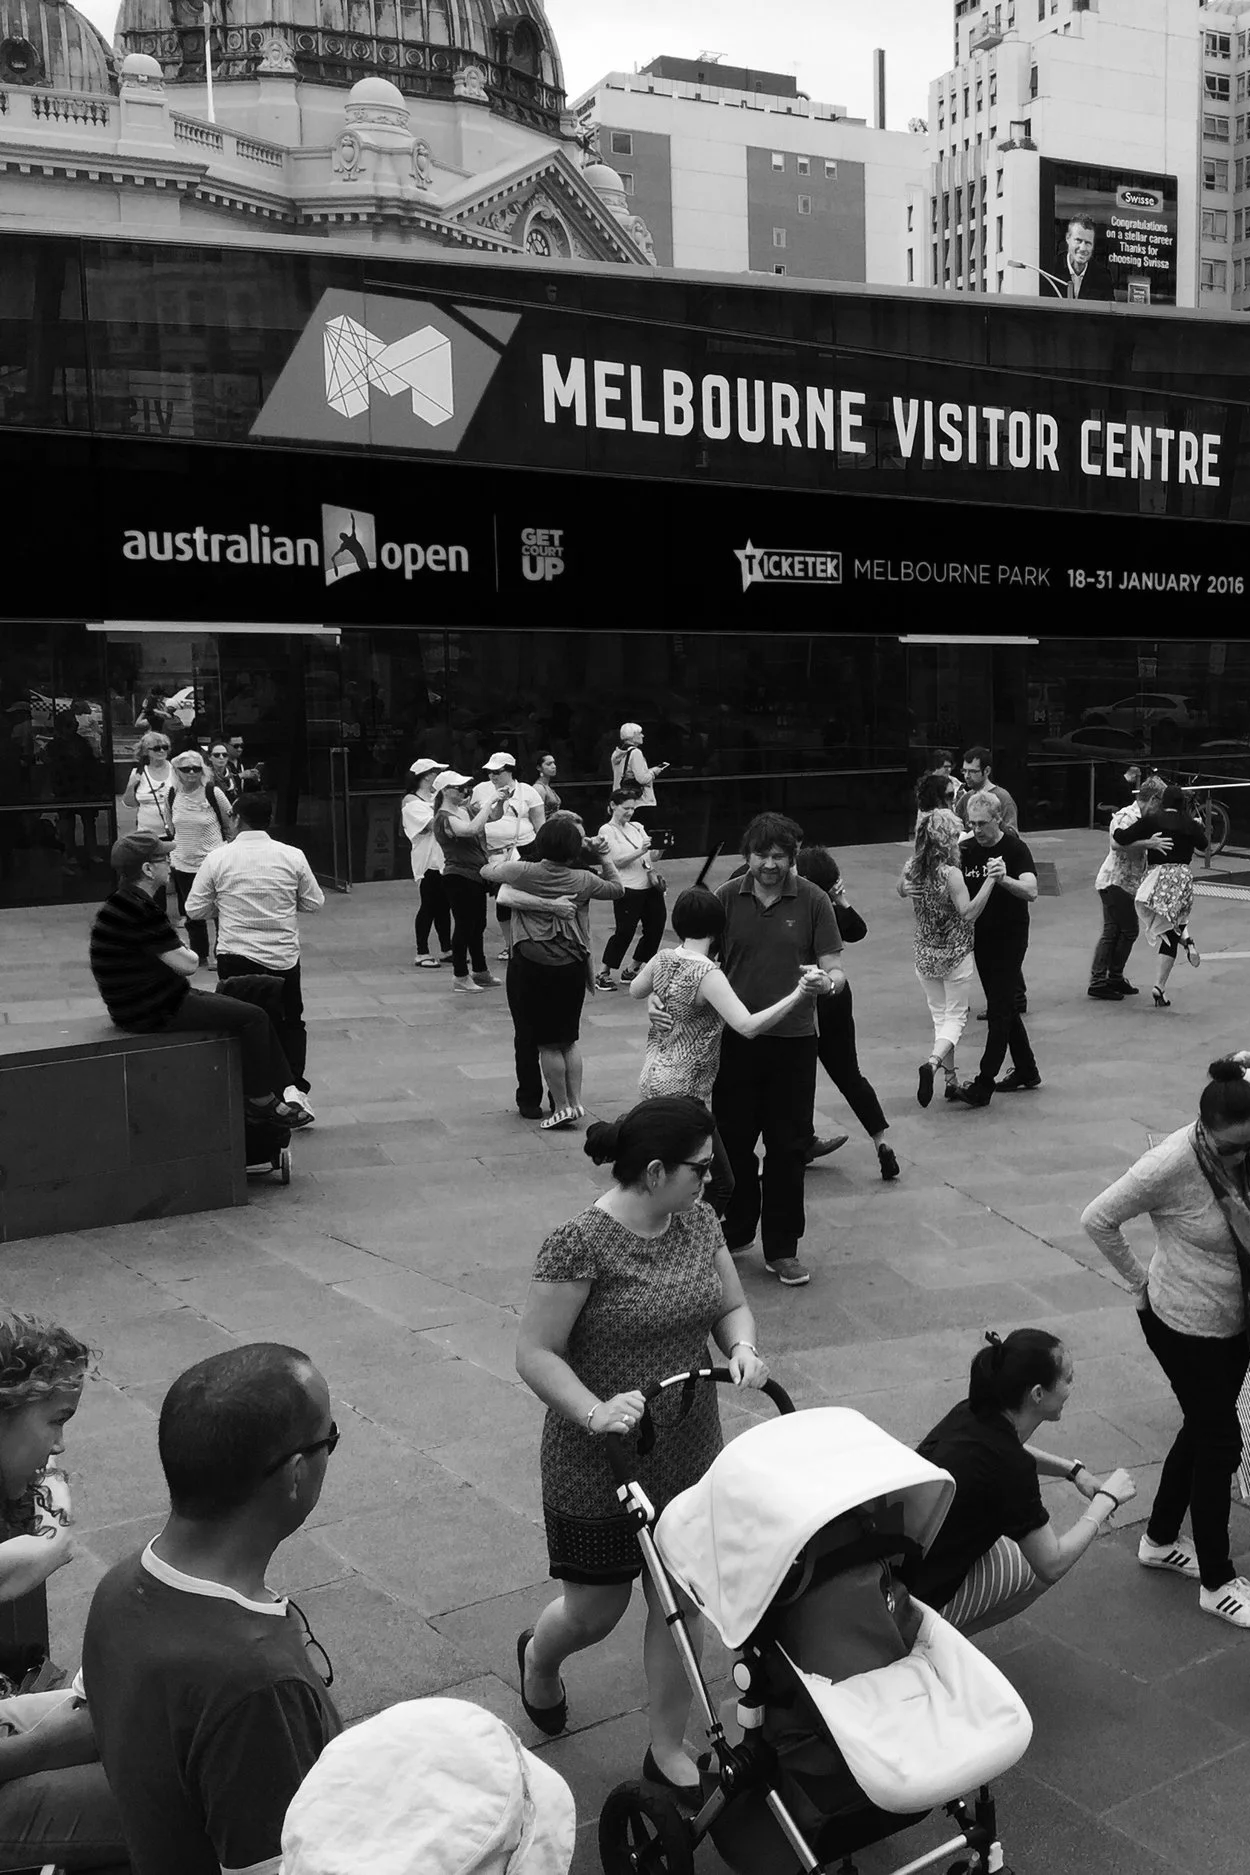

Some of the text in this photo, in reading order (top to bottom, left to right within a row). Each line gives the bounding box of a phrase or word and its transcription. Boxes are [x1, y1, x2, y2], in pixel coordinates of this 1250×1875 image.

[1125, 191, 1155, 206] Swisse
[1111, 215, 1168, 233] Congratulations
[1106, 229, 1116, 239] on
[1124, 230, 1148, 242] stellar
[1149, 235, 1174, 246] career
[1120, 241, 1158, 256] Thanks for
[1108, 252, 1170, 269] choosing Swisse
[542, 353, 1221, 487] MELBOURNE VISITOR CENTRE
[521, 527, 564, 546] GET
[123, 524, 469, 580] australian open
[522, 545, 564, 557] COURT
[522, 555, 565, 581] UP
[744, 554, 839, 578] TICKETEK
[854, 558, 991, 585] MELBOURNE
[998, 565, 1050, 587] PARK
[1067, 569, 1113, 589] 18-31
[1118, 571, 1201, 592] JANUARY
[1207, 576, 1244, 594] 2016
